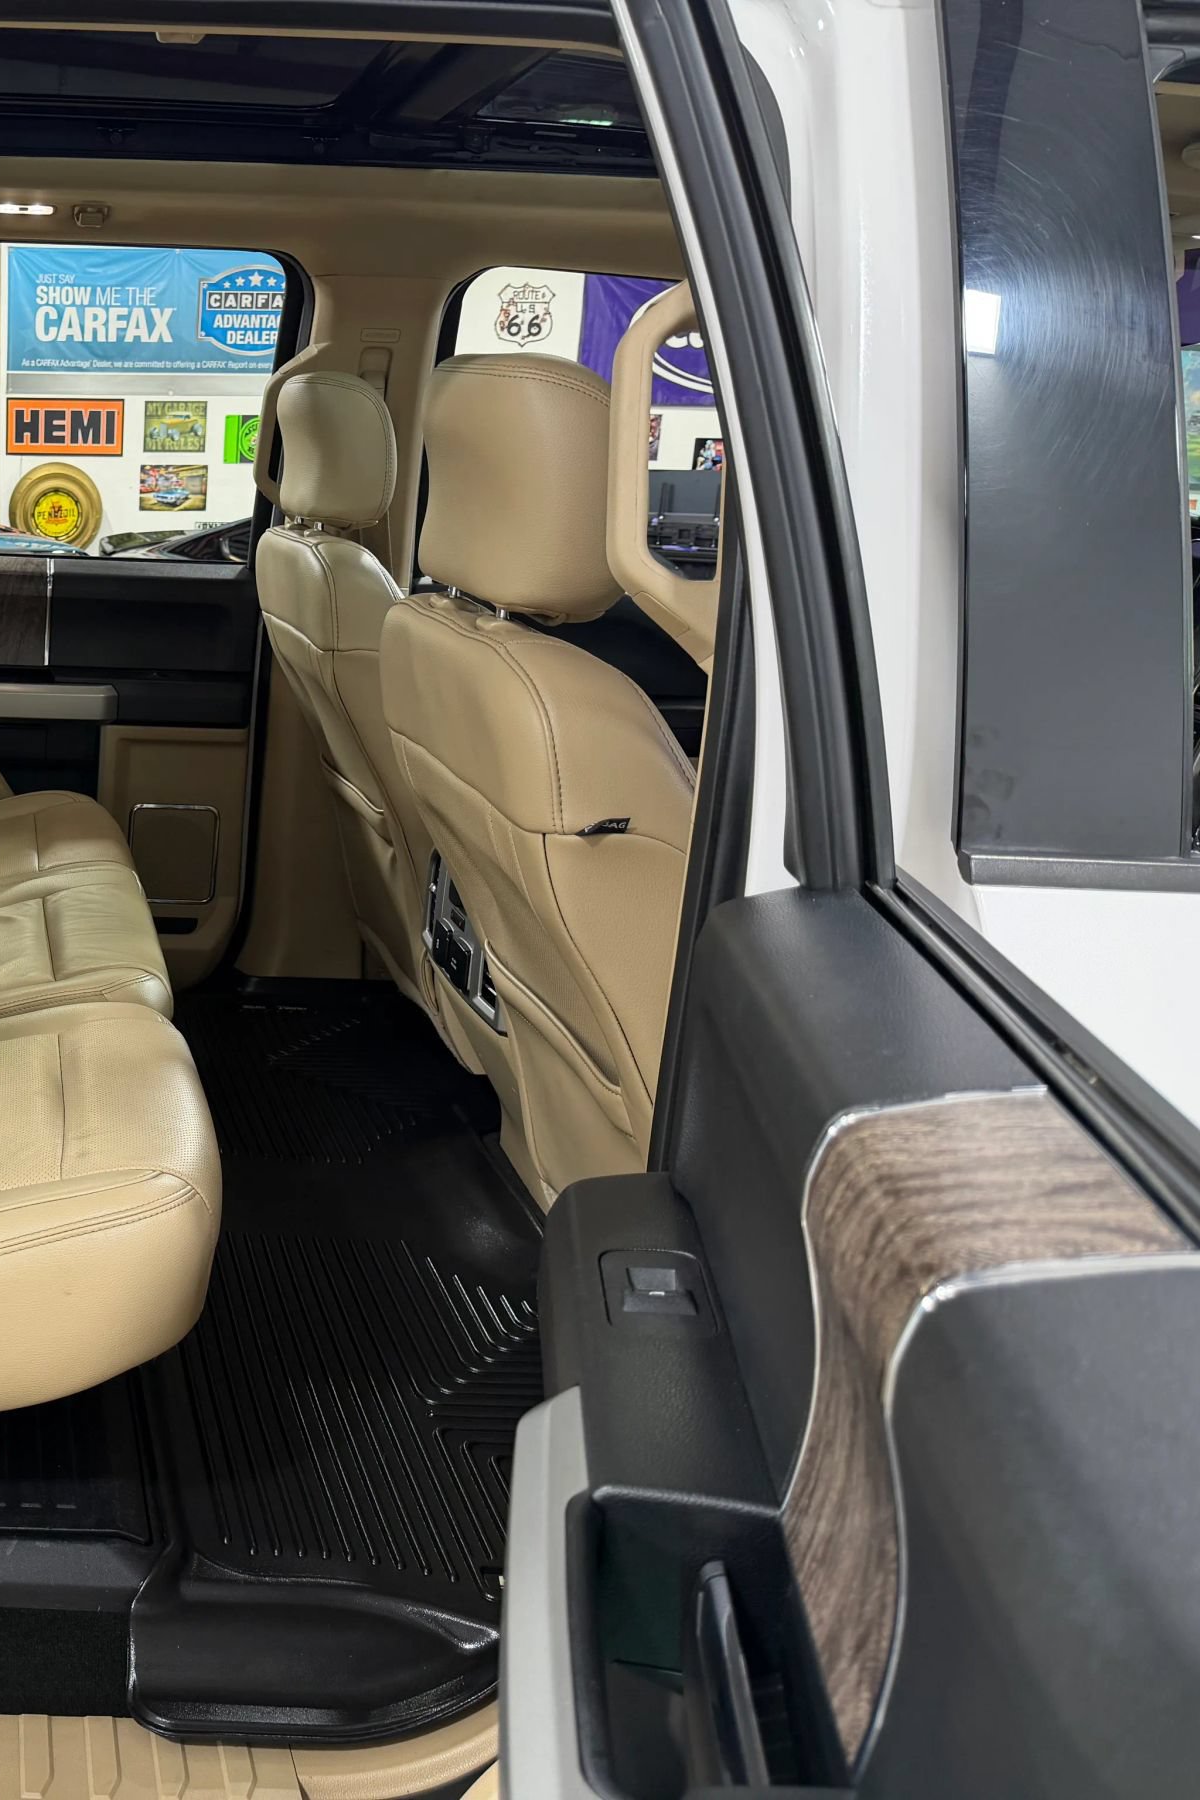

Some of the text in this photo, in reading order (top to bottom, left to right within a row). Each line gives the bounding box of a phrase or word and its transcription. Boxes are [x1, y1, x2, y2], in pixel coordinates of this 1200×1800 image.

[35, 273, 76, 284] JUST SAY
[35, 285, 157, 306] SHOW ME THE
[34, 305, 174, 343] CARFAX
[213, 314, 280, 329] ADVANTA
[507, 314, 542, 337] 66
[226, 330, 278, 345] DEALER
[13, 409, 116, 445] HEMI
